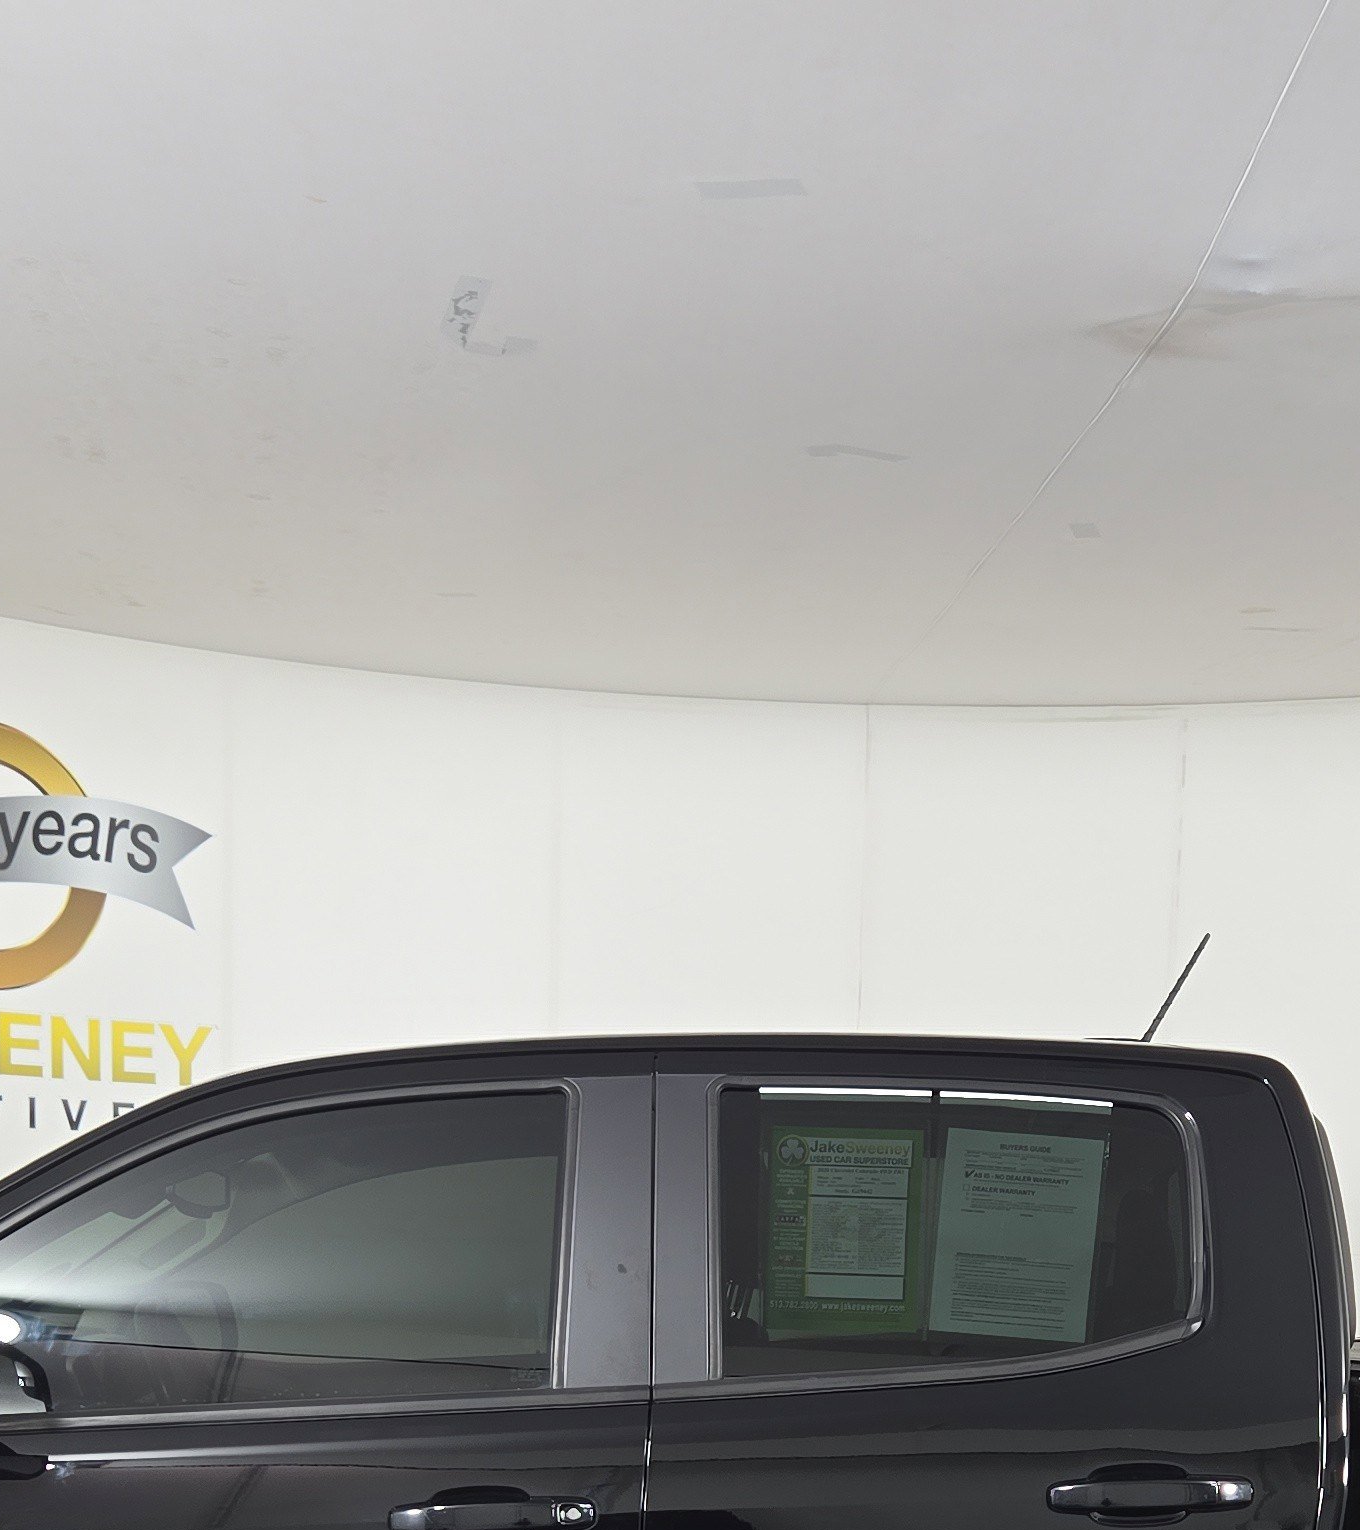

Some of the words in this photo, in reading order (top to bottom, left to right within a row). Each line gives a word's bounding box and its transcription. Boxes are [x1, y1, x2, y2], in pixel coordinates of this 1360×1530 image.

[1029, 1145, 1052, 1154] GUIDE
[809, 1155, 832, 1164] USED
[834, 1155, 852, 1164] CAR
[853, 1156, 910, 1166] SUPERSTORE
[1005, 1175, 1032, 1183] DEALER
[1032, 1177, 1070, 1186] WARRANTY
[972, 1185, 998, 1194] DEALER
[998, 1188, 1037, 1196] WARRANTY
